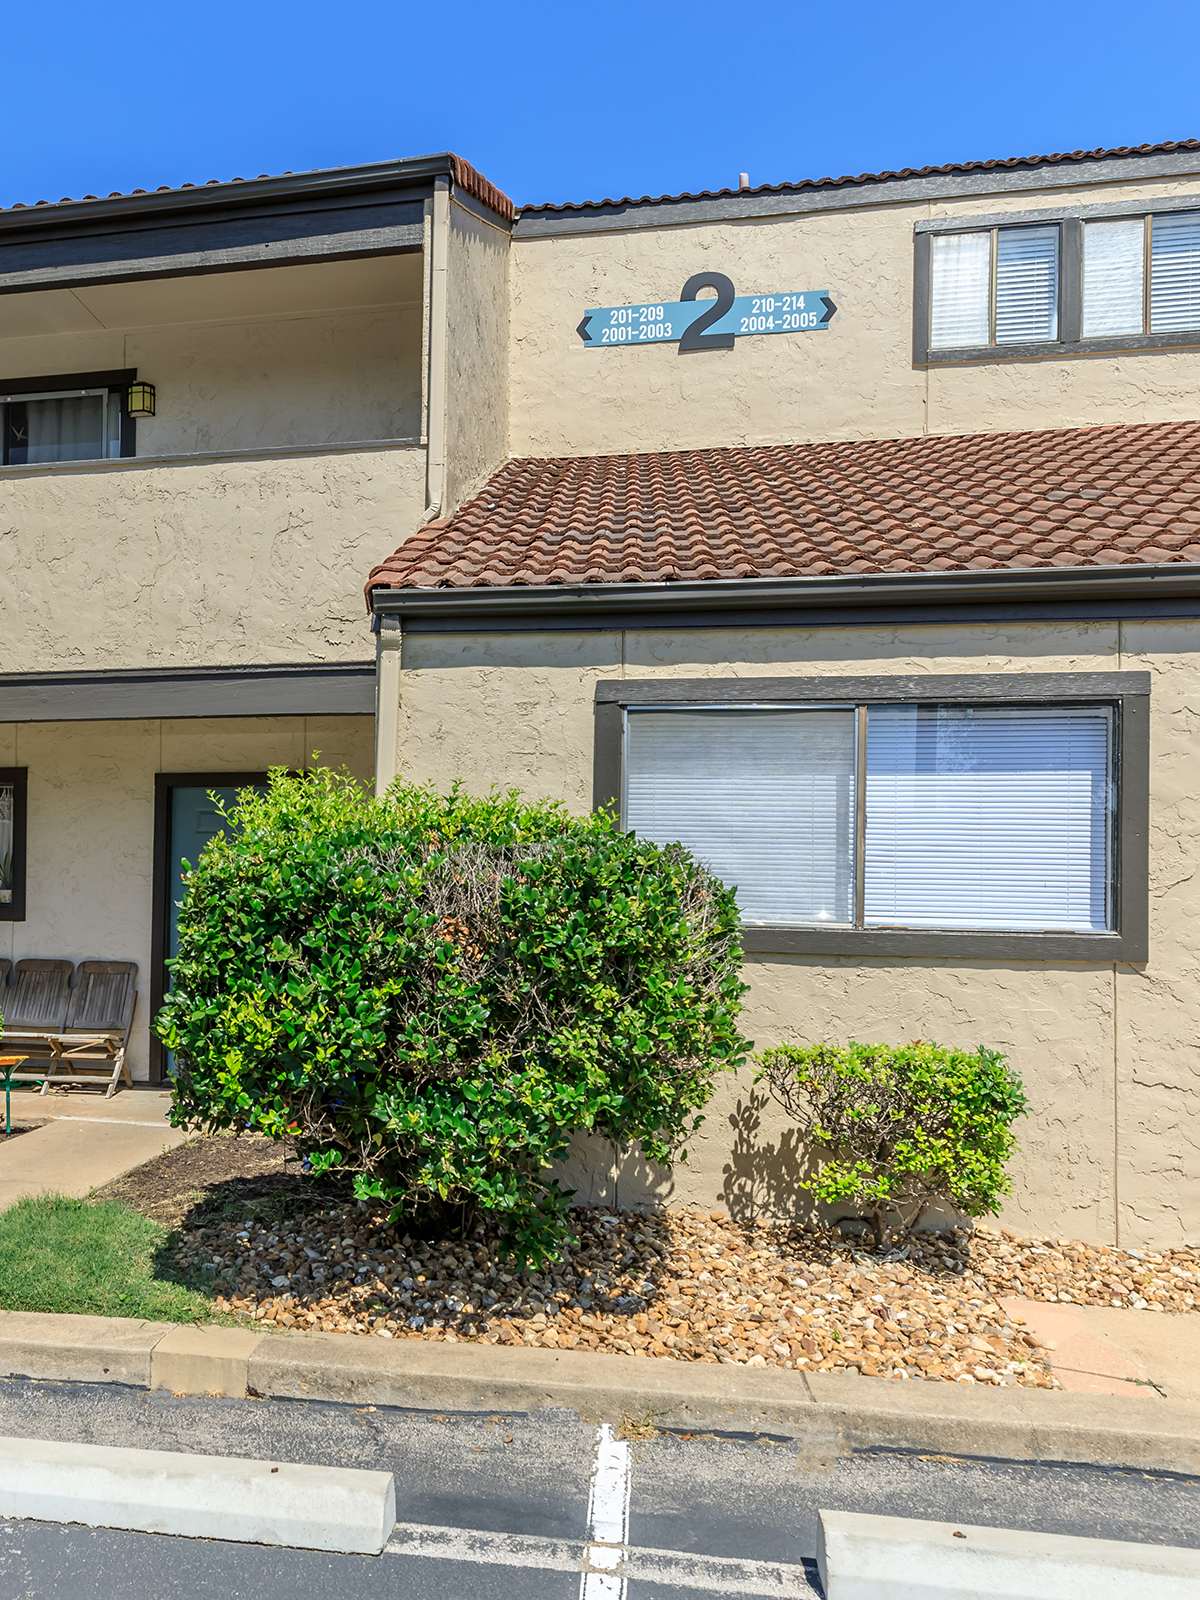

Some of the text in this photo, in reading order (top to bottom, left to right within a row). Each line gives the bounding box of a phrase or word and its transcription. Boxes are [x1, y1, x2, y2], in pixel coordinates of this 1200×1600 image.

[678, 271, 735, 353] 2
[752, 295, 805, 314] 210-214
[610, 306, 664, 325] 201-209
[740, 312, 817, 332] 2004-2005
[601, 322, 672, 342] 2001-2003
